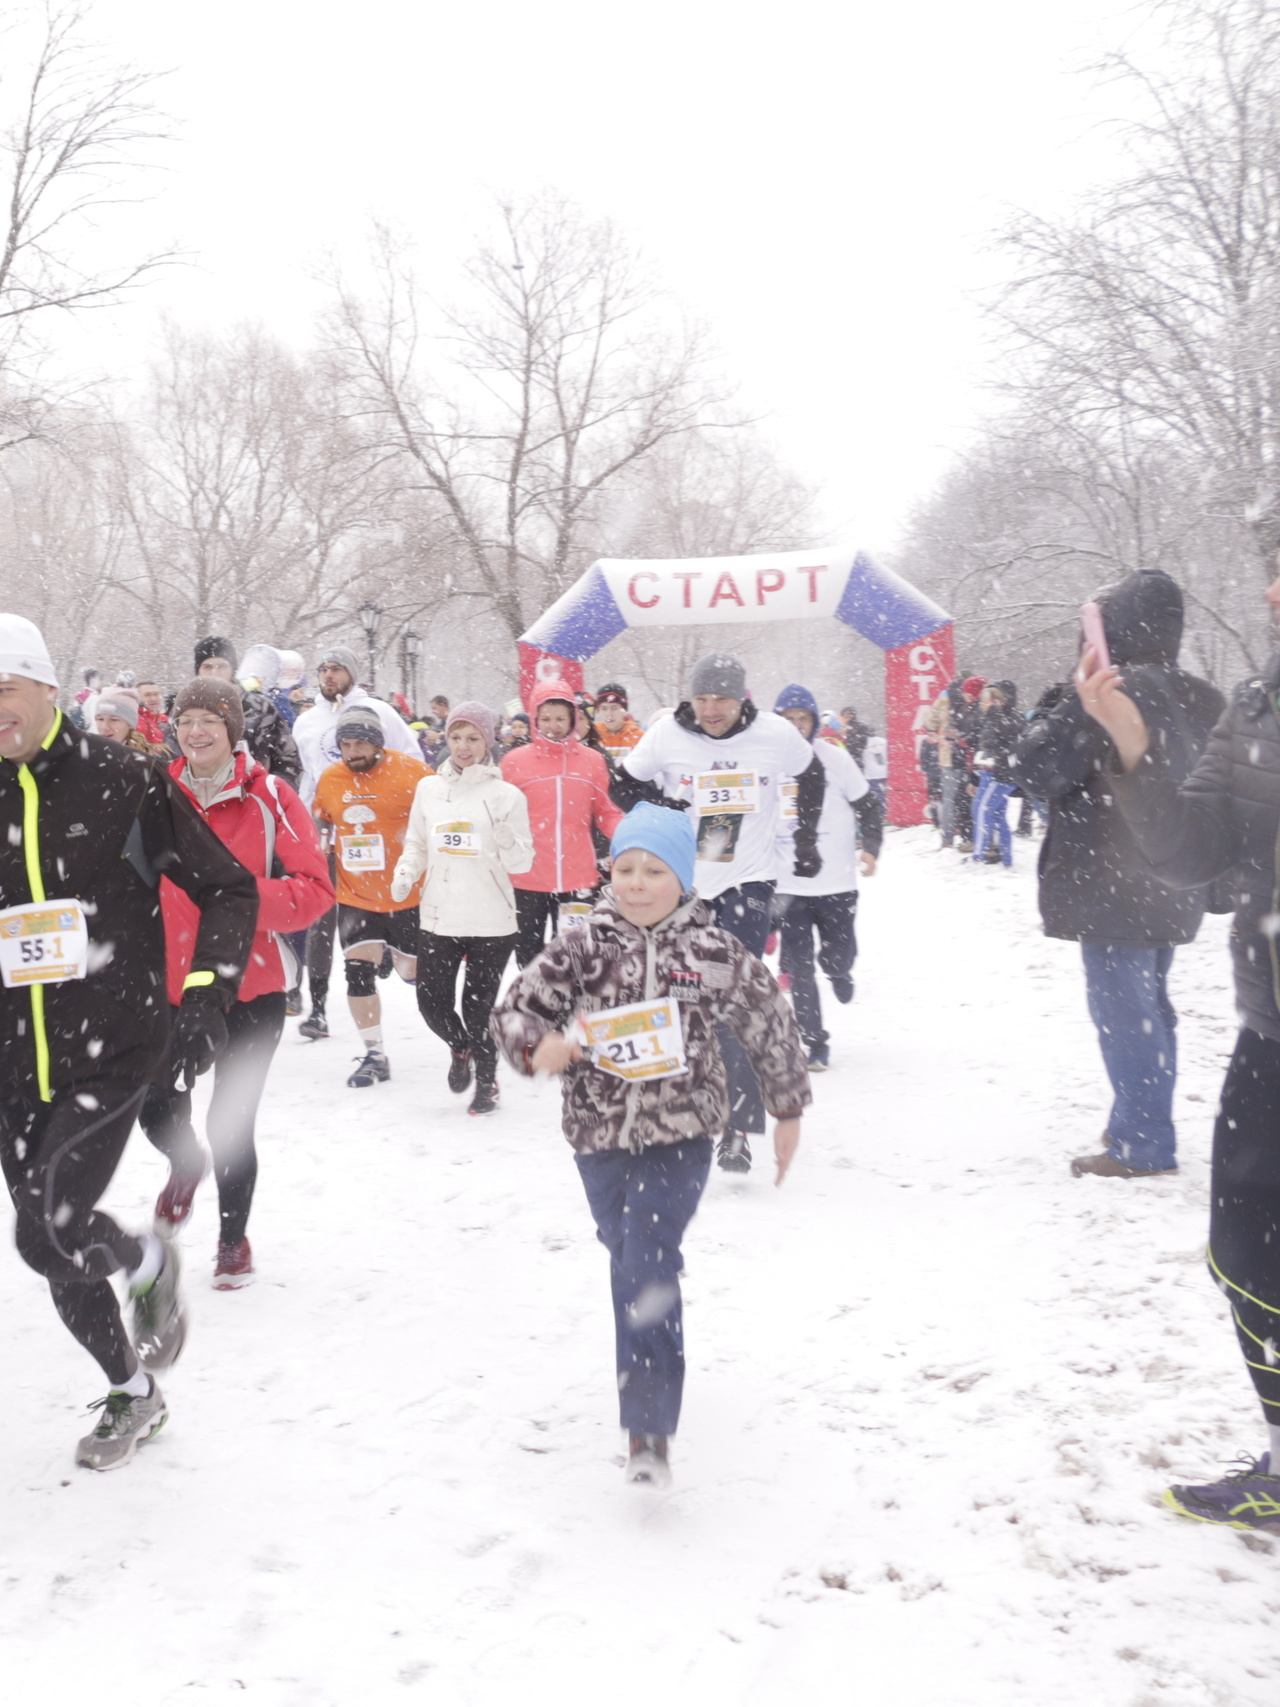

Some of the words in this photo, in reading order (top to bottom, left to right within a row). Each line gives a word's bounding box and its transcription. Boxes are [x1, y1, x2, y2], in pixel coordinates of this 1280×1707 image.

[627, 564, 829, 609] СТАРТ
[709, 789, 746, 803] 33-1
[443, 834, 472, 847] 39-1
[348, 848, 373, 860] 54-1
[20, 937, 64, 963] 55-1
[607, 1035, 664, 1064] 21-1
